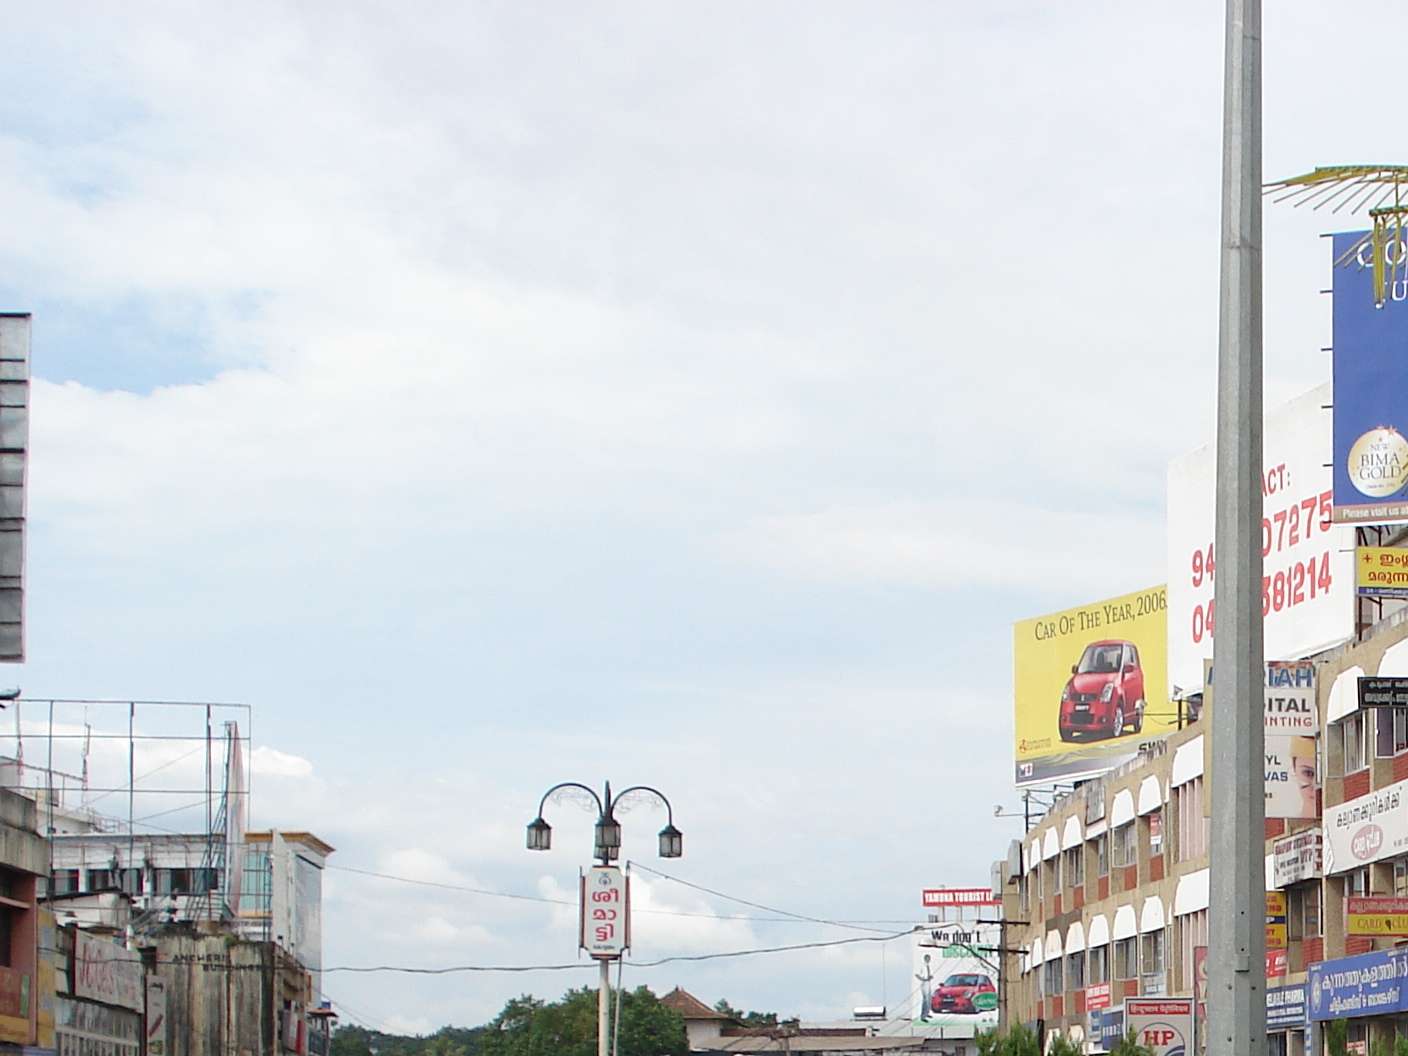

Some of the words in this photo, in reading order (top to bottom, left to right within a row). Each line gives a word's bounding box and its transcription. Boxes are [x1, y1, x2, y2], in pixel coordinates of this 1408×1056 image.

[1361, 452, 1400, 467] BIMA
[1360, 466, 1401, 480] GOLD
[1143, 1030, 1175, 1046] HP
